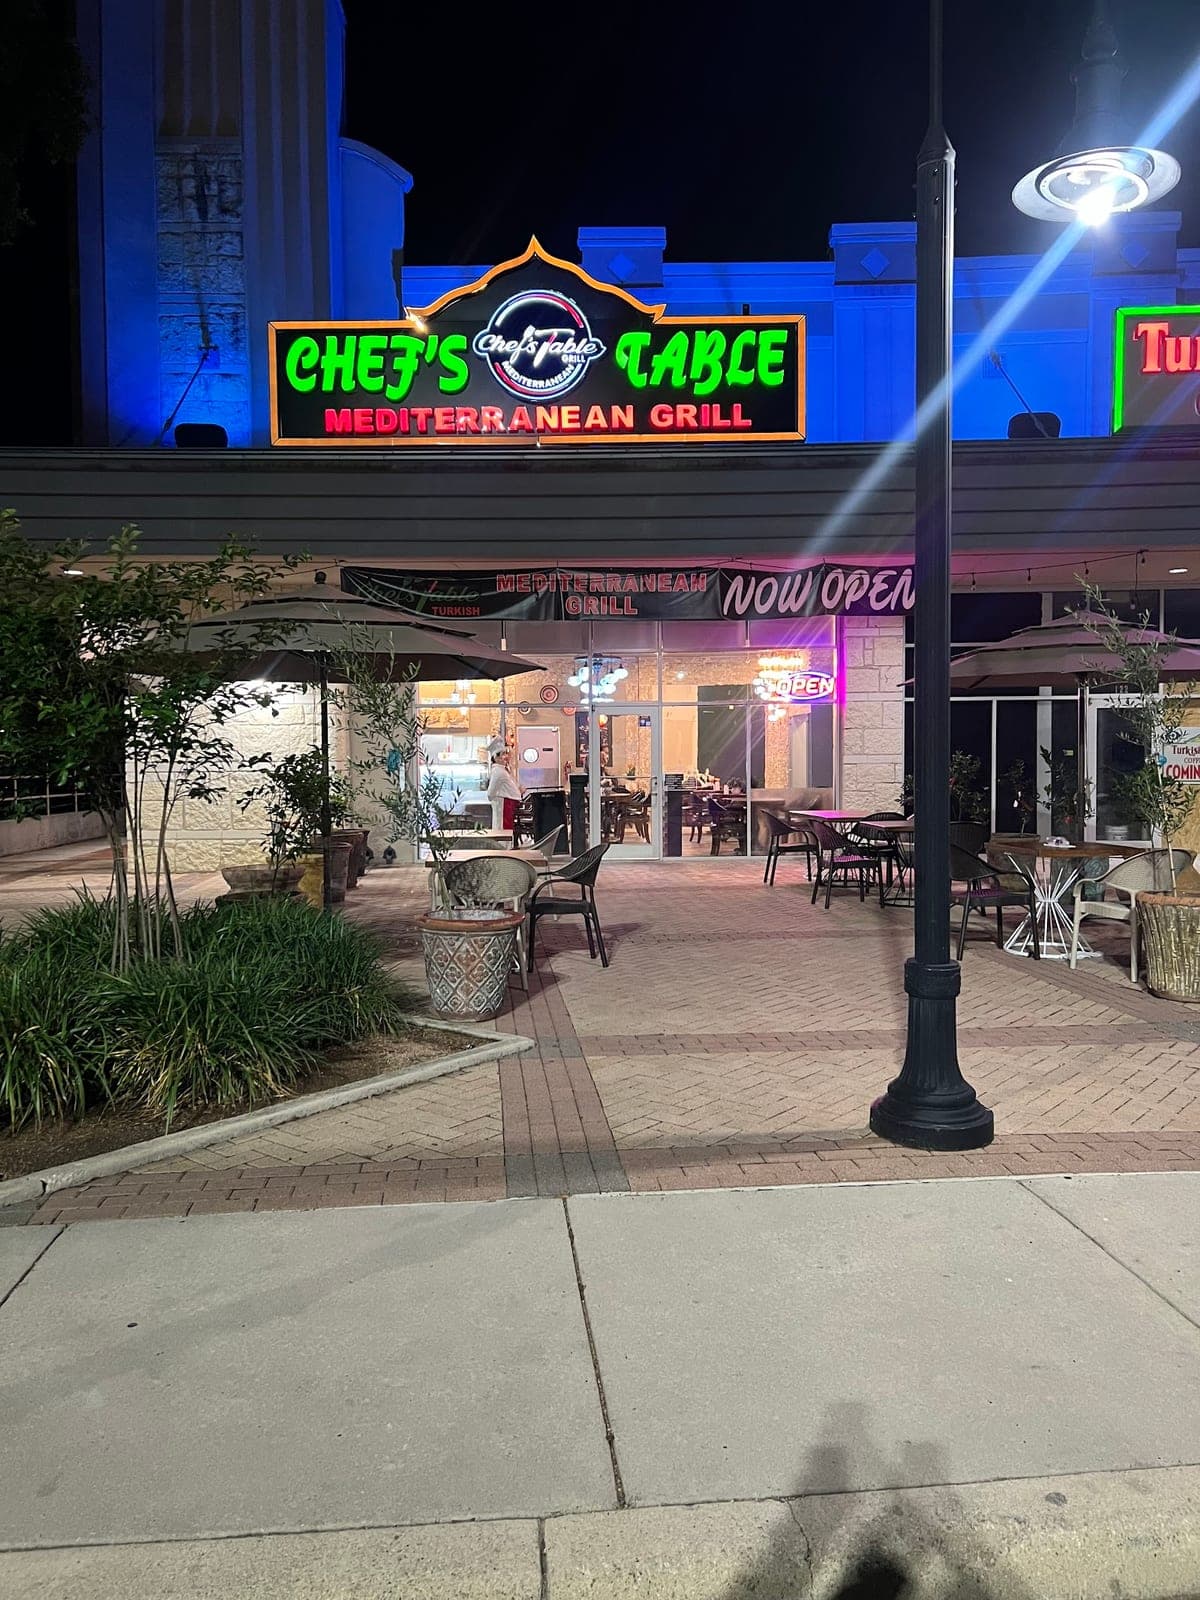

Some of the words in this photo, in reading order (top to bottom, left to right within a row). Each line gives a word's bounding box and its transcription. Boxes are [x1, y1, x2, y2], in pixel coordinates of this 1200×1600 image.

[478, 325, 539, 364] Chef's
[534, 328, 598, 368] Table
[561, 353, 586, 364] GRILL
[1132, 321, 1200, 374] Tu
[285, 332, 470, 401] CHEF'S
[615, 329, 788, 398] TABLE
[501, 361, 576, 389] MEDITERRANEAN
[324, 404, 635, 435] MEDITERRANEAN
[649, 402, 753, 431] GRILL
[496, 573, 707, 593] MEDITERRANEAN
[723, 571, 814, 616] NOW
[821, 568, 916, 612] OPEN
[431, 606, 481, 616] TURKISH
[565, 595, 638, 615] GRILL
[776, 677, 835, 695] OPEN
[1172, 745, 1200, 756] Turkis
